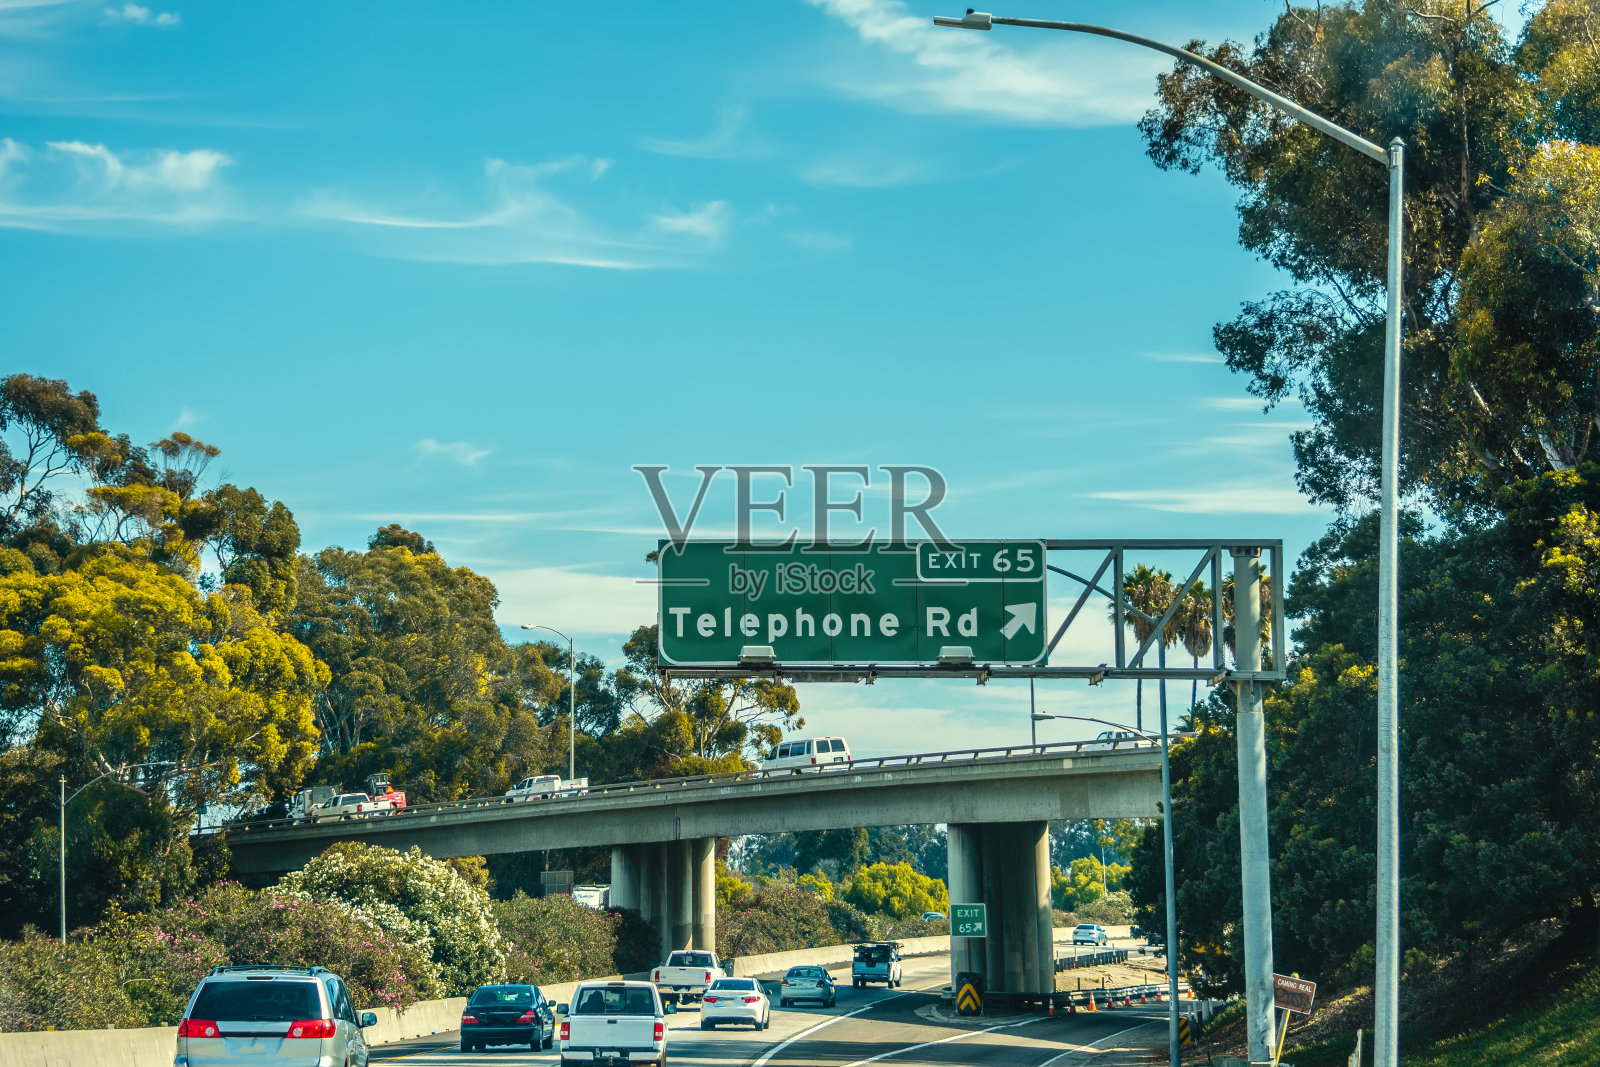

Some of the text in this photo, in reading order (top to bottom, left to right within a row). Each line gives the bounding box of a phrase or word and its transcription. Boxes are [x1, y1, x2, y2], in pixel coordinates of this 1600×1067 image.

[928, 549, 1035, 572] EXIT 65
[668, 606, 978, 644] Telephone Rd
[957, 909, 979, 918] EXIT
[959, 923, 972, 933] 65
[1277, 978, 1312, 993] CAMINO REAL
